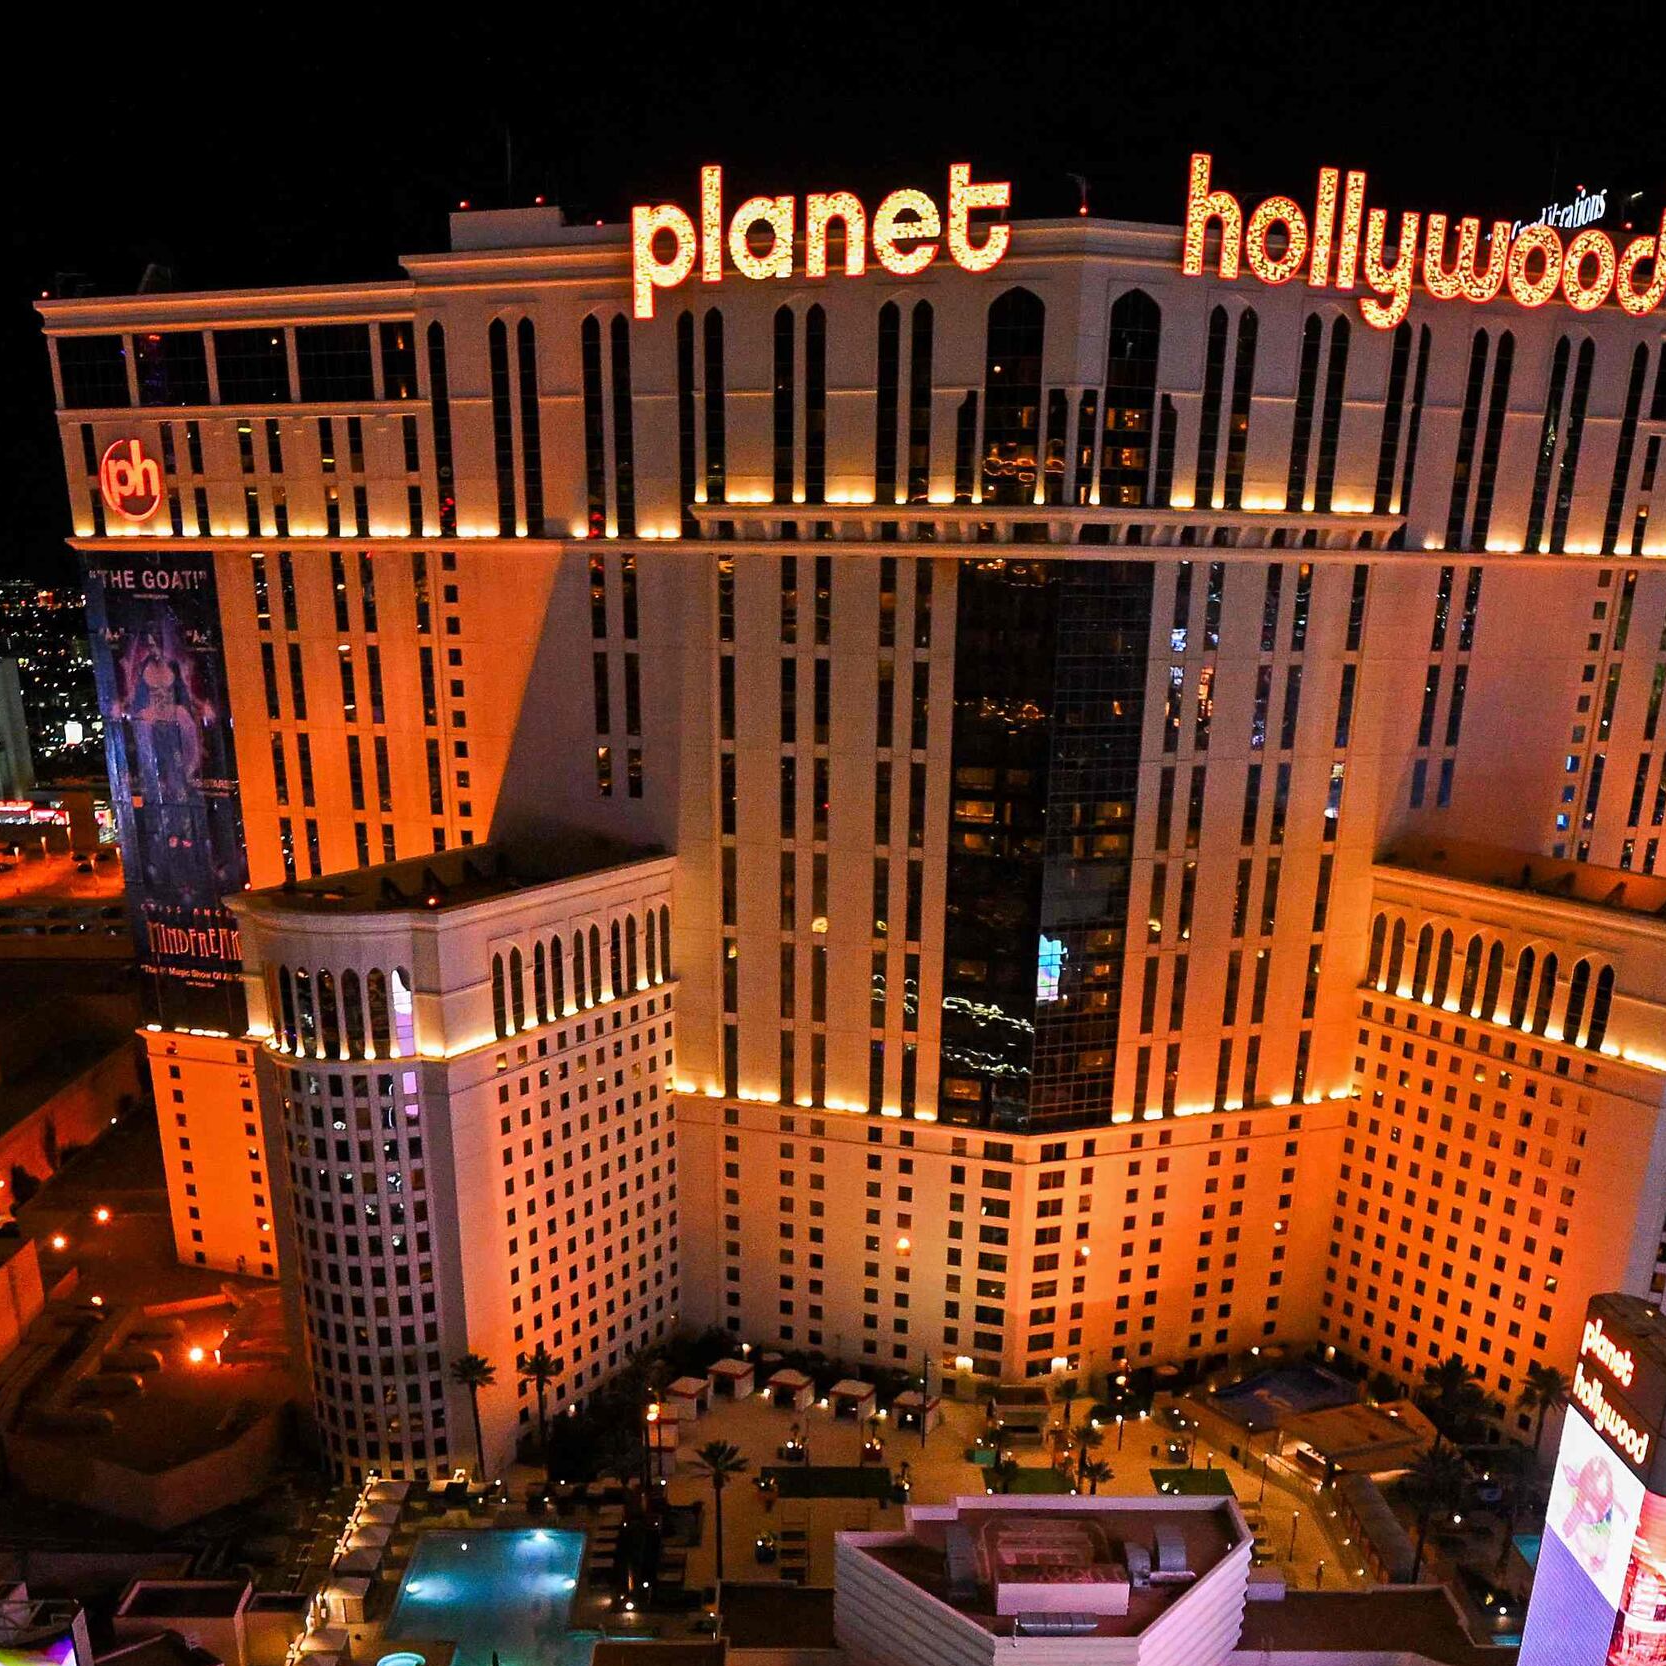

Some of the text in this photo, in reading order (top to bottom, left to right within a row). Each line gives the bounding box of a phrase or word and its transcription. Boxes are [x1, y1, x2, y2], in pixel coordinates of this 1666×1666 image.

[631, 163, 1012, 320] planet
[108, 441, 159, 499] ph
[1582, 1318, 1635, 1388] planet
[1572, 1361, 1650, 1465] hollywood
